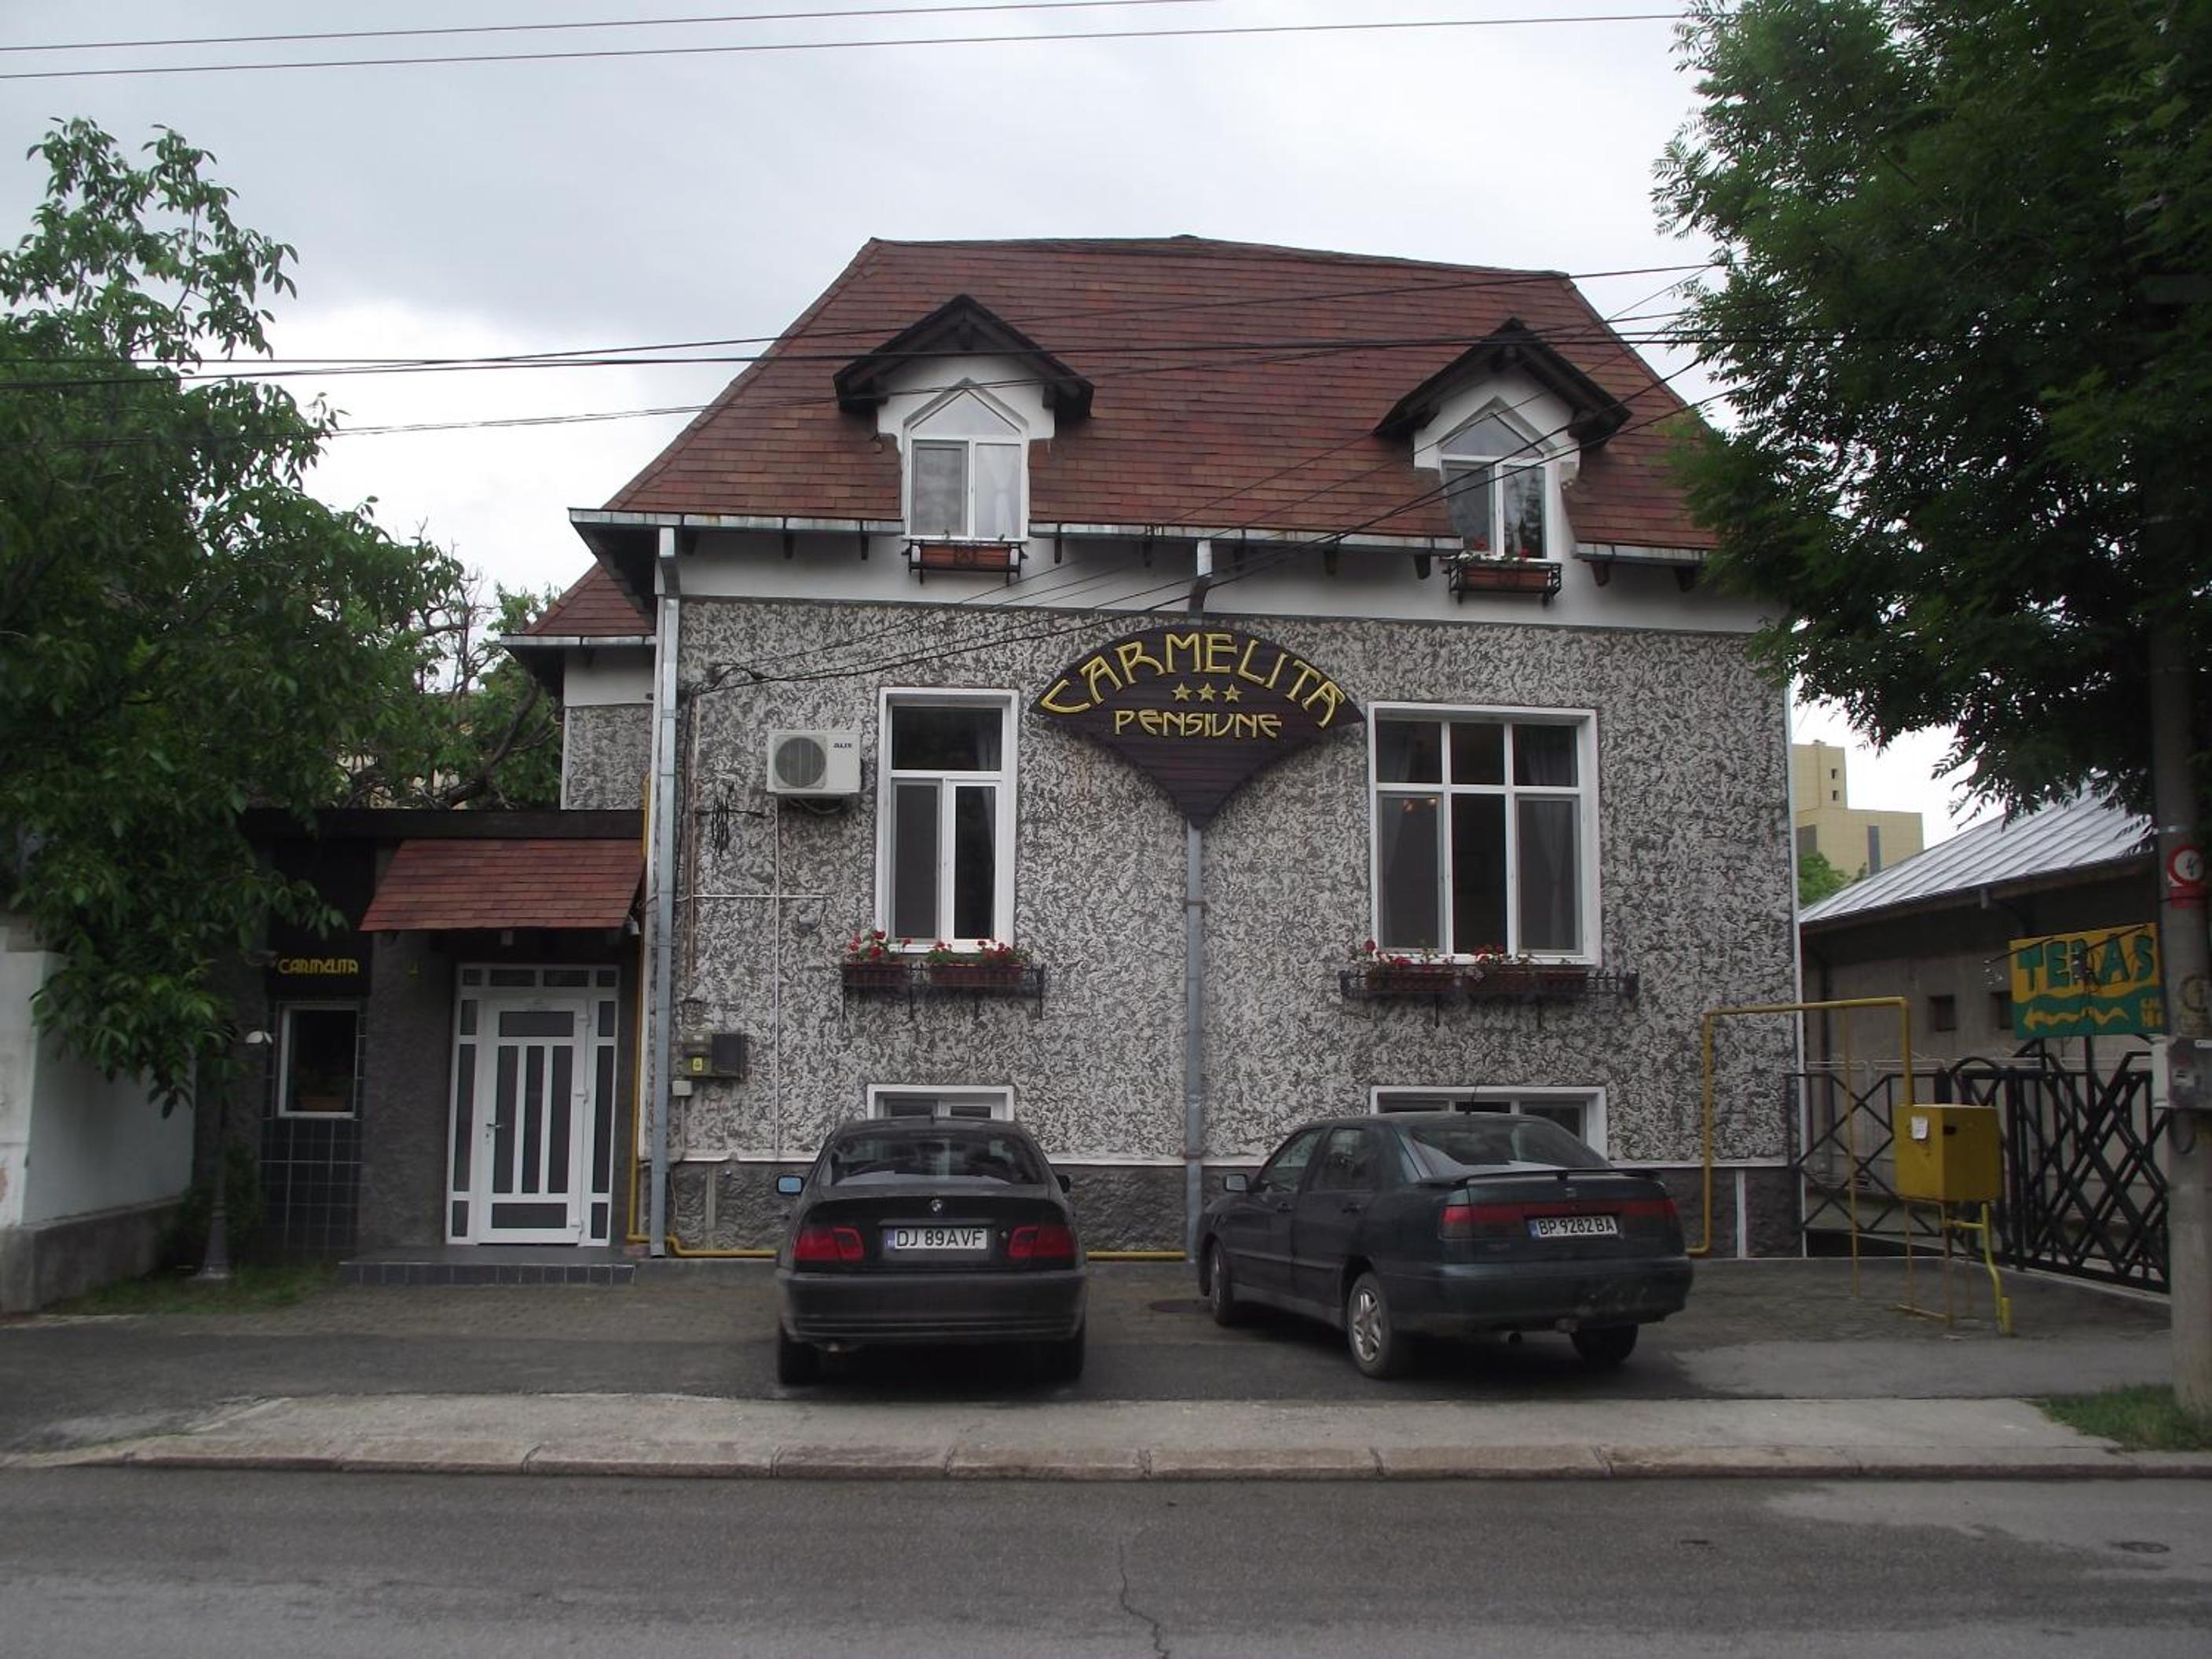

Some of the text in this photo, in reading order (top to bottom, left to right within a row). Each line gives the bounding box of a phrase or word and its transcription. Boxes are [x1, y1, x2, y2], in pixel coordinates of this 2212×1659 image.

[1040, 632, 1346, 729] CARMELITA
[1114, 709, 1282, 738] PENSIUNE
[277, 958, 359, 974] CARMELITA
[1539, 1218, 1614, 1235] BP 9282 BA
[897, 1230, 917, 1247] DJ
